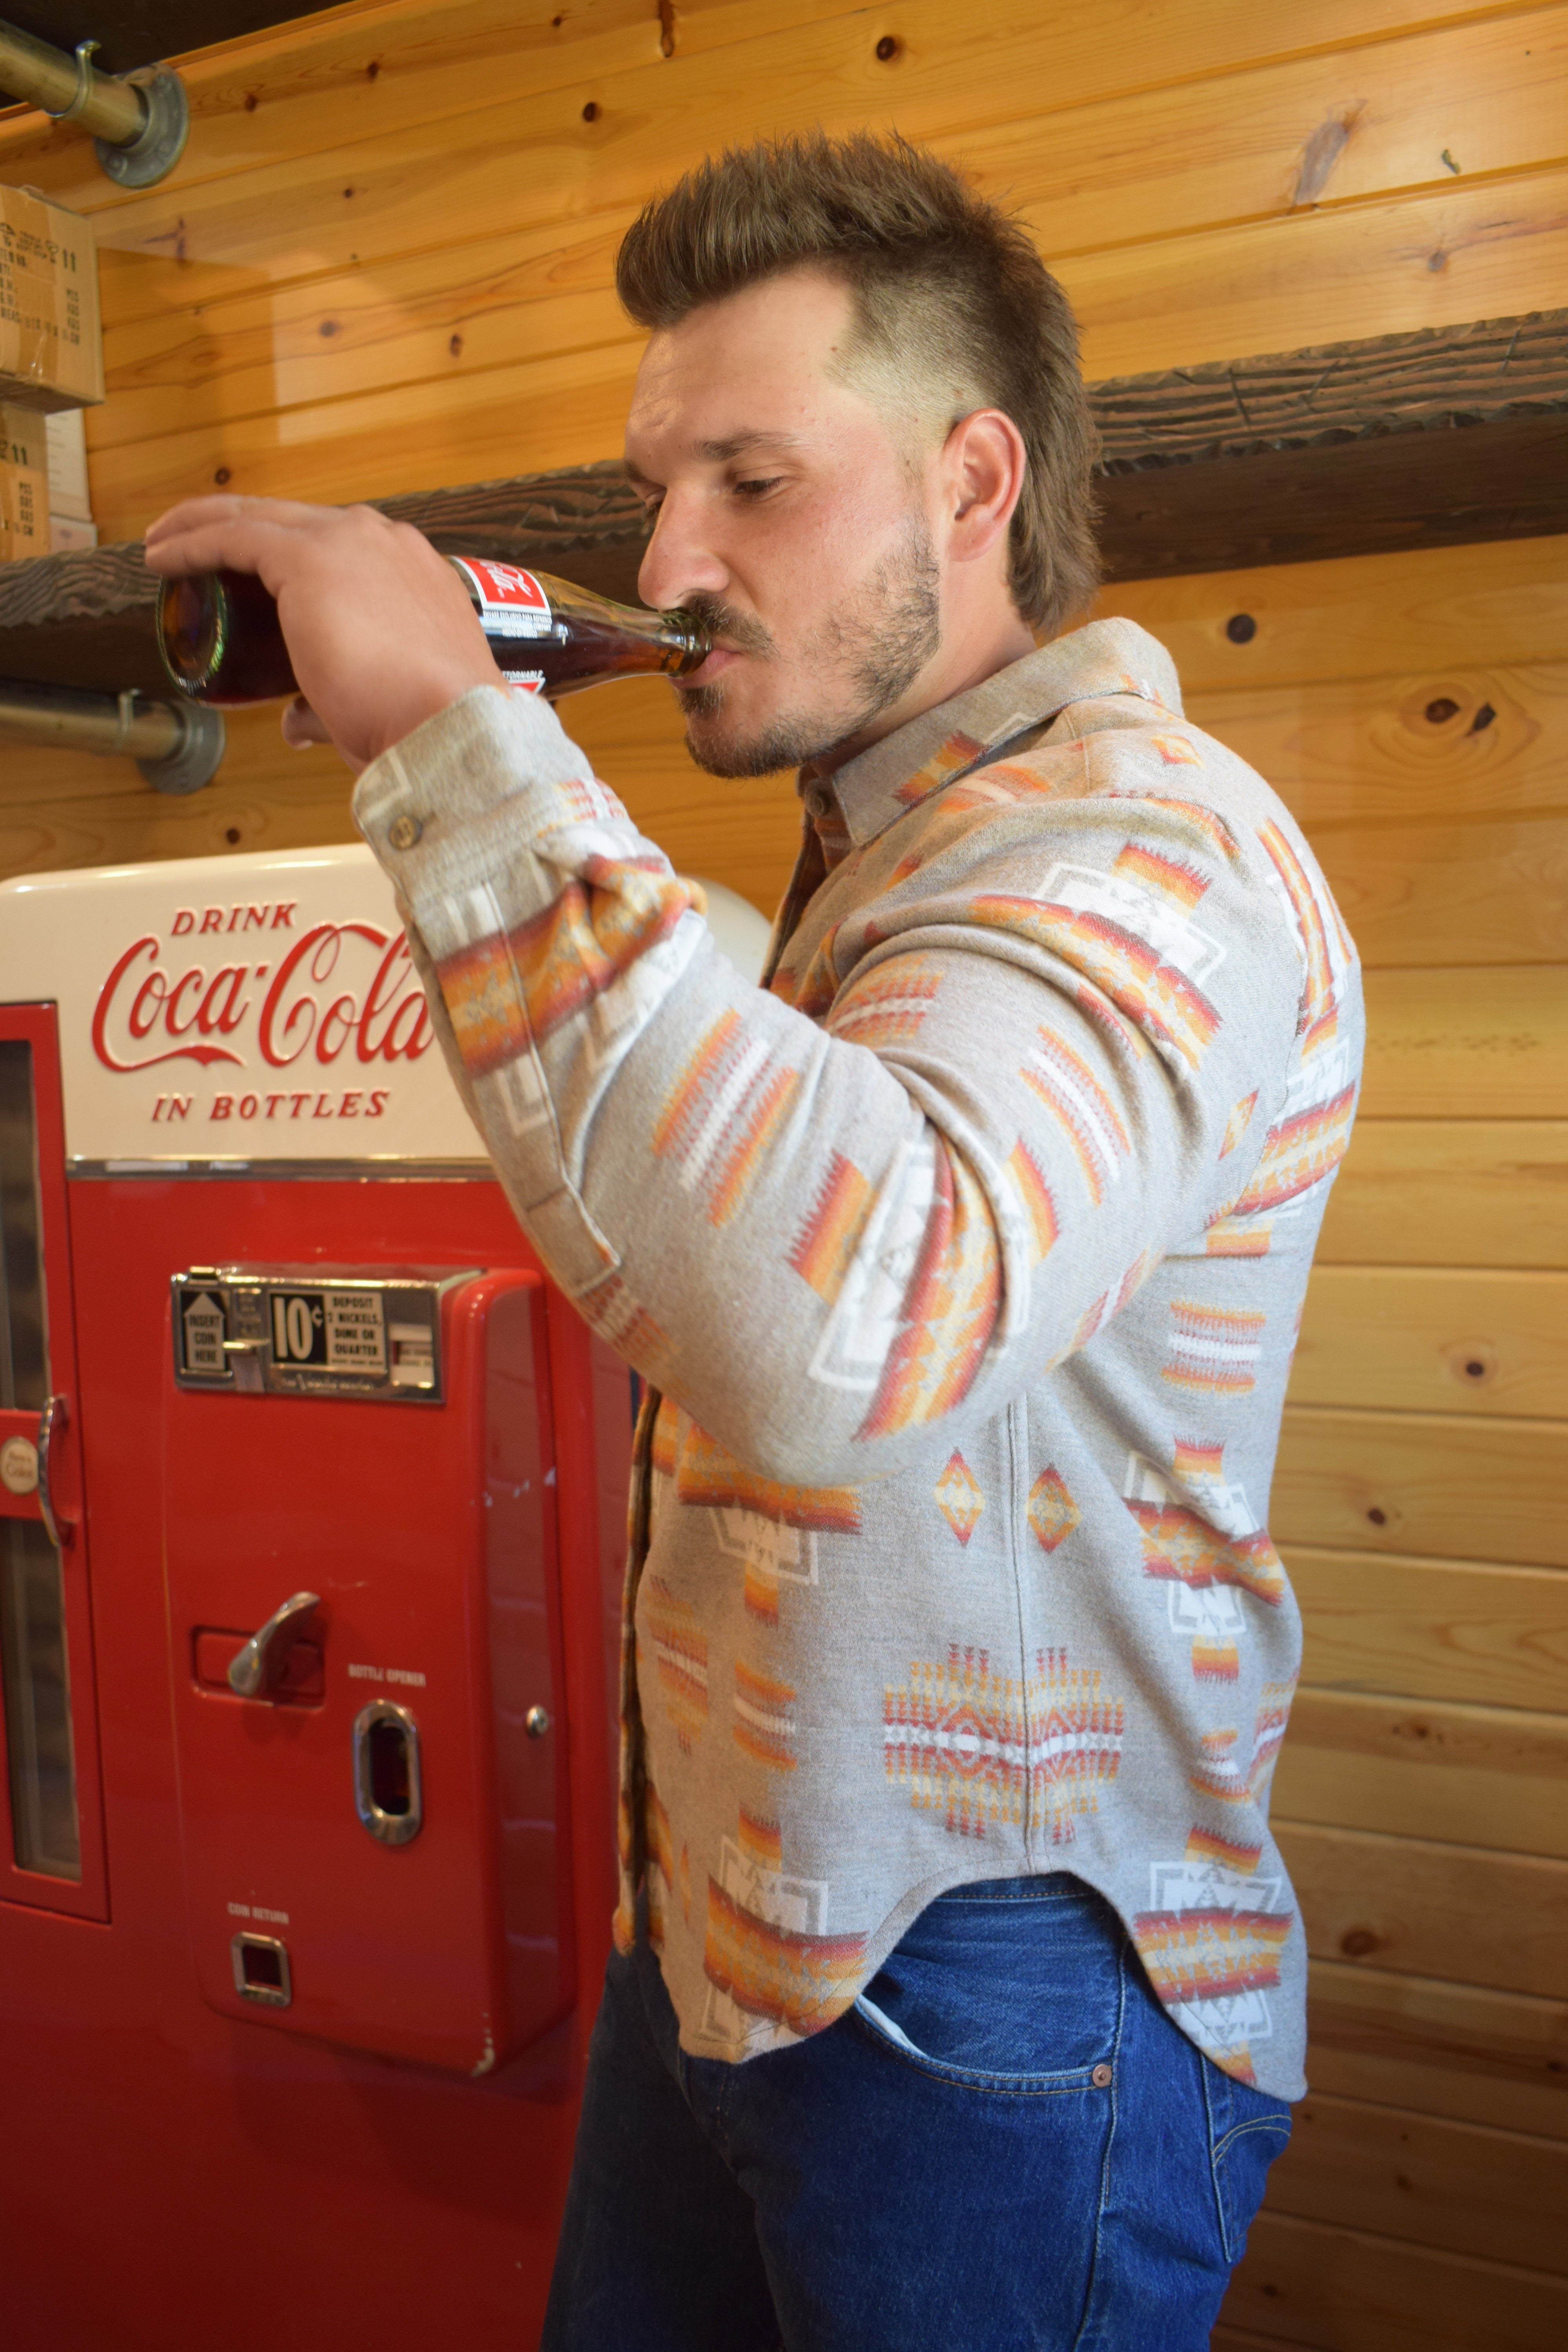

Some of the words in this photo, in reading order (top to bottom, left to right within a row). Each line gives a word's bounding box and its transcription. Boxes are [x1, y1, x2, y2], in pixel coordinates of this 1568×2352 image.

[500, 611, 522, 621] EXCLUSIVO
[522, 613, 533, 622] PARA
[533, 614, 552, 624] REFRESCO
[502, 670, 544, 680] ETORNABLE
[171, 903, 297, 935] DRINK
[91, 921, 434, 1073] Coca-Cola
[151, 1098, 190, 1122] IN
[209, 1090, 390, 1122] BOTTLES
[332, 1296, 373, 1308] DEPOSIT
[189, 1315, 220, 1328] INSERT
[194, 1332, 216, 1345] COIN
[335, 1328, 357, 1339] DIME
[363, 1329, 374, 1340] OR
[195, 1349, 216, 1363] HERE
[335, 1343, 377, 1356] QUARTER
[348, 1663, 384, 1682] BOTTLE
[386, 1668, 427, 1688] OPENER
[227, 1902, 250, 1918] COIN
[251, 1906, 290, 1925] RETURN
